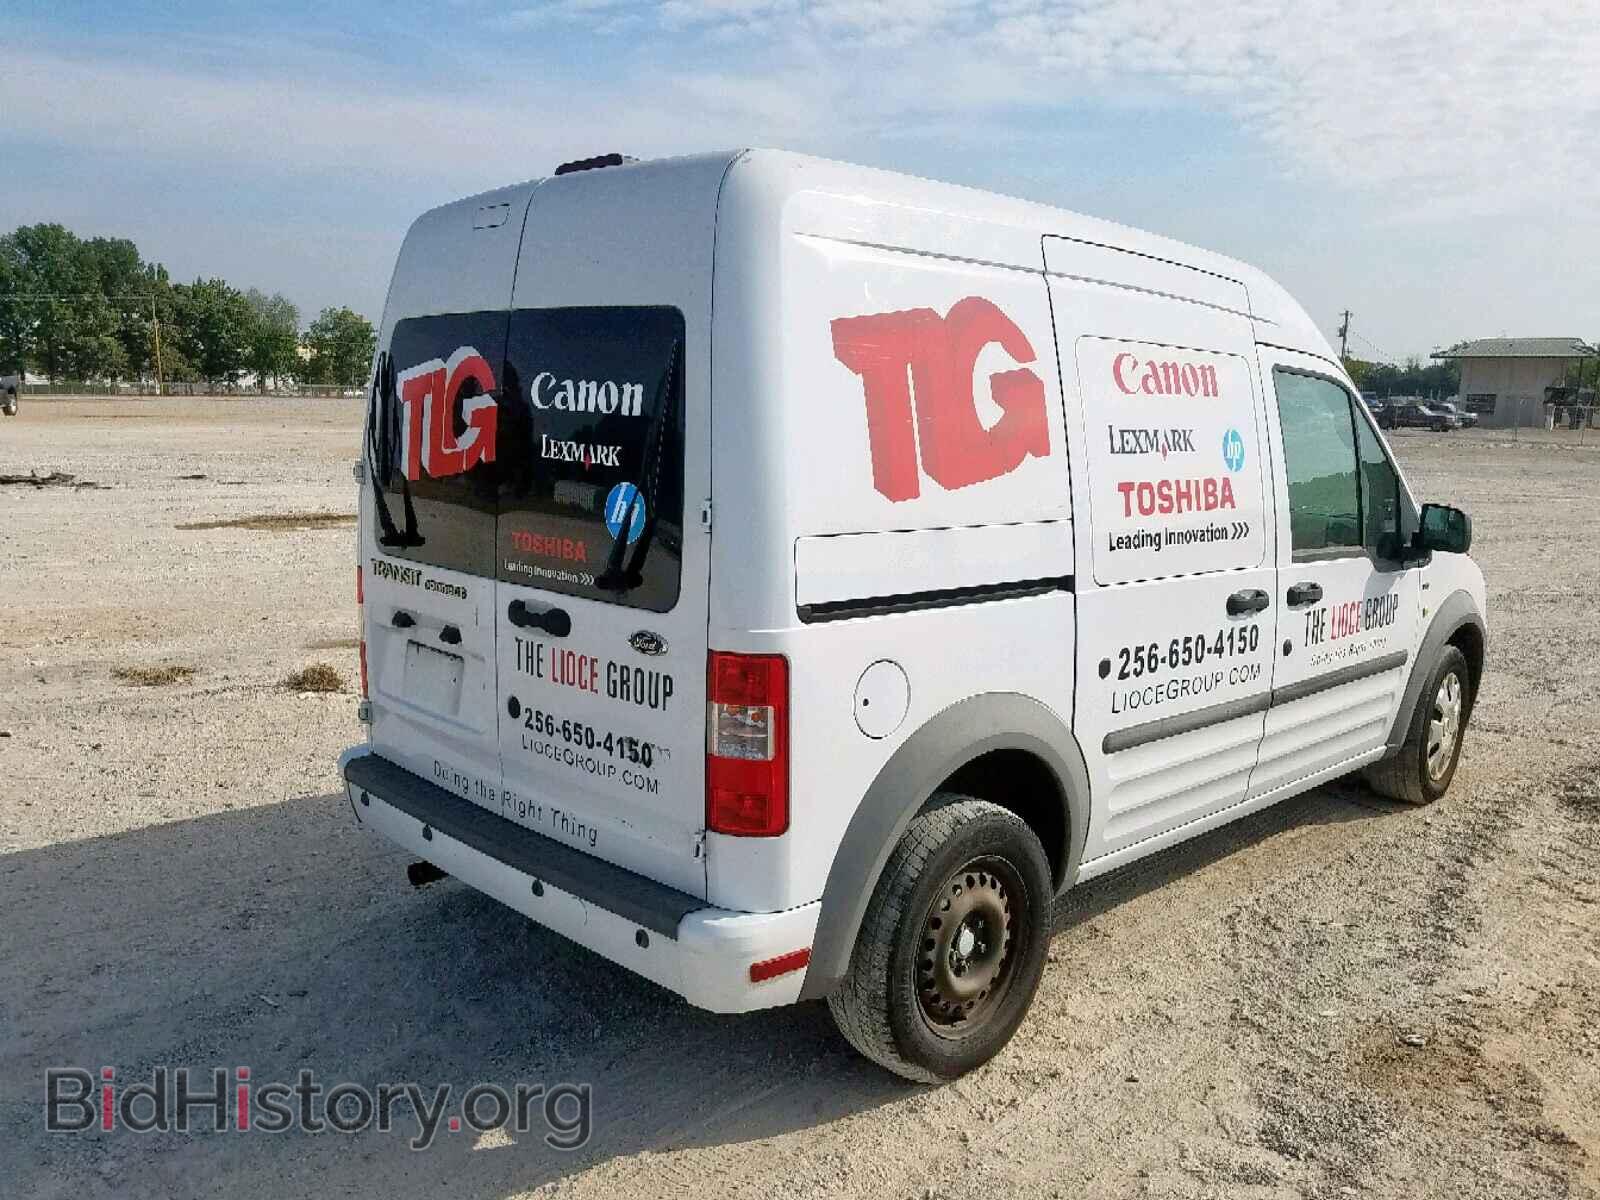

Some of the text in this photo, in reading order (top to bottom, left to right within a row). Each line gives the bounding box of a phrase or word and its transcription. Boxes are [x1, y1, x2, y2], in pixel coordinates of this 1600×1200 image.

[530, 372, 643, 417] Canon
[1113, 352, 1219, 397] Canon
[541, 434, 622, 469] LEXMARK
[1108, 425, 1196, 459] LEXMARK
[1117, 477, 1236, 517] TOSHIBA
[511, 530, 587, 562] TOSHIBA
[1109, 523, 1228, 552] Leading Innovation
[371, 558, 422, 586] TRANSIT
[504, 560, 578, 583] Leading Innovation
[1304, 594, 1399, 647] THE LIOCE GROUP
[1118, 624, 1259, 680] 256-650-4150
[515, 637, 674, 711] THE LIOCE GROUP
[524, 707, 652, 769] 256-650-4150
[434, 760, 598, 847] Doing the Right Thing
